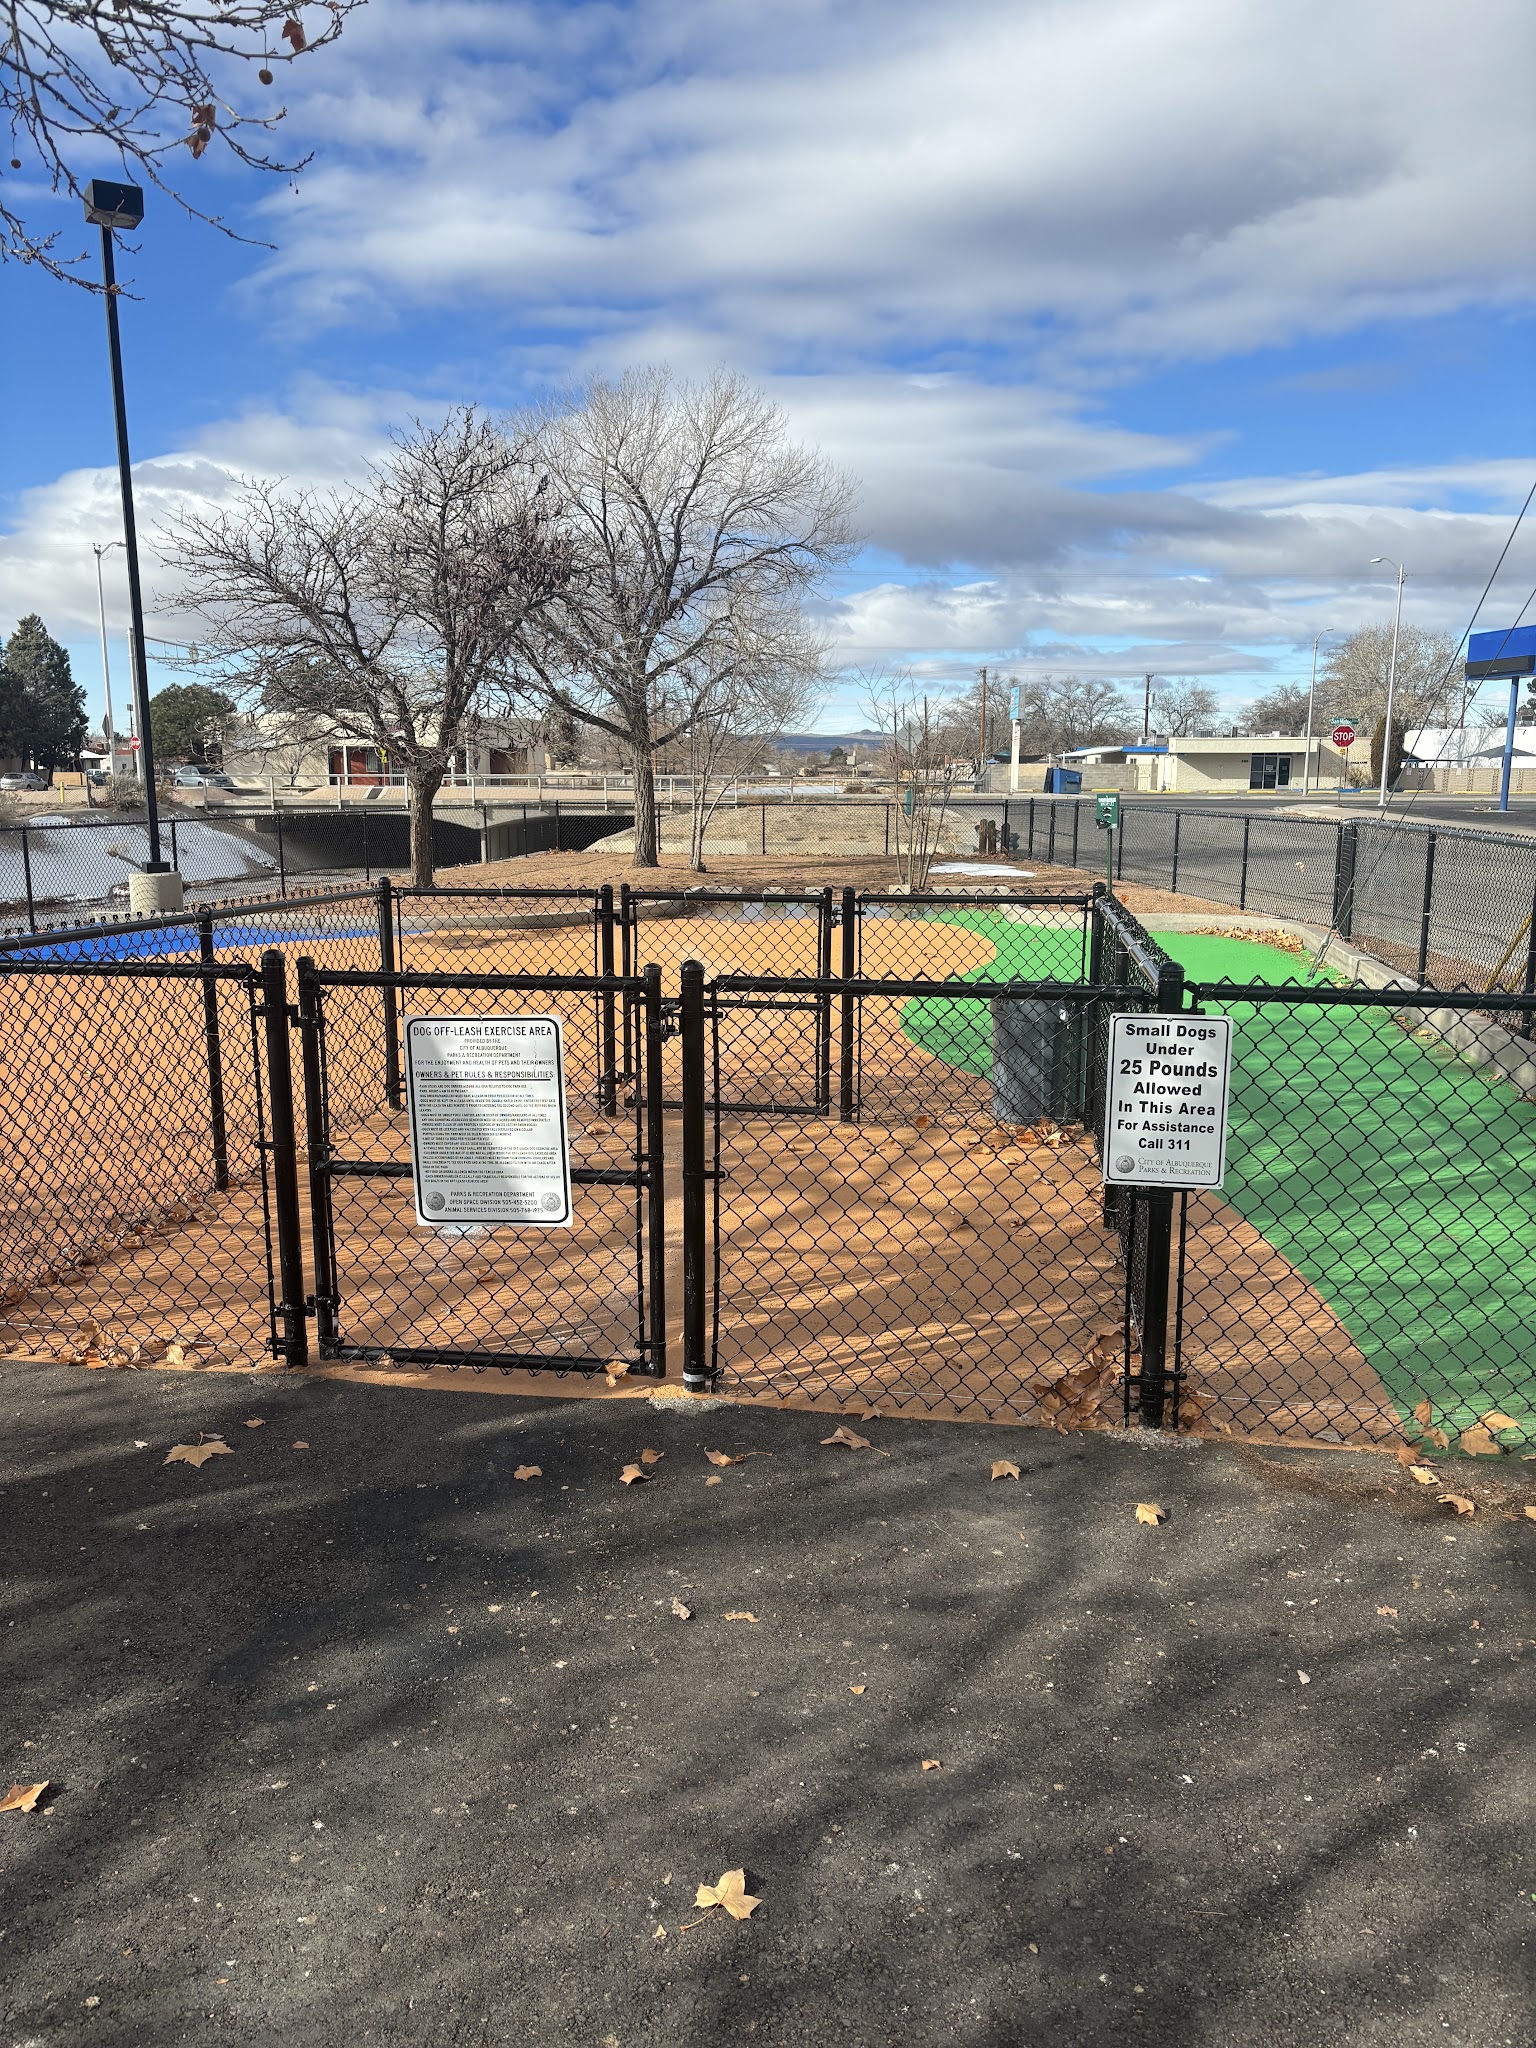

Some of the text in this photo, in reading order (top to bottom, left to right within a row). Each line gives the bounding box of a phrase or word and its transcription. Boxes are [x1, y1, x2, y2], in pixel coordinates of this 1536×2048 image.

[1334, 732, 1354, 741] STOP
[413, 1027, 552, 1036] DOG OFF-LEASH EXERCISE AREA
[1125, 1024, 1216, 1041] Small Dogs
[1146, 1043, 1195, 1056] Under
[1120, 1059, 1218, 1078] 25 Pounds
[1133, 1081, 1202, 1096] Allowed
[1118, 1100, 1215, 1116] In This Area
[1117, 1119, 1214, 1133] For Assistance
[1138, 1137, 1190, 1150] Call 311
